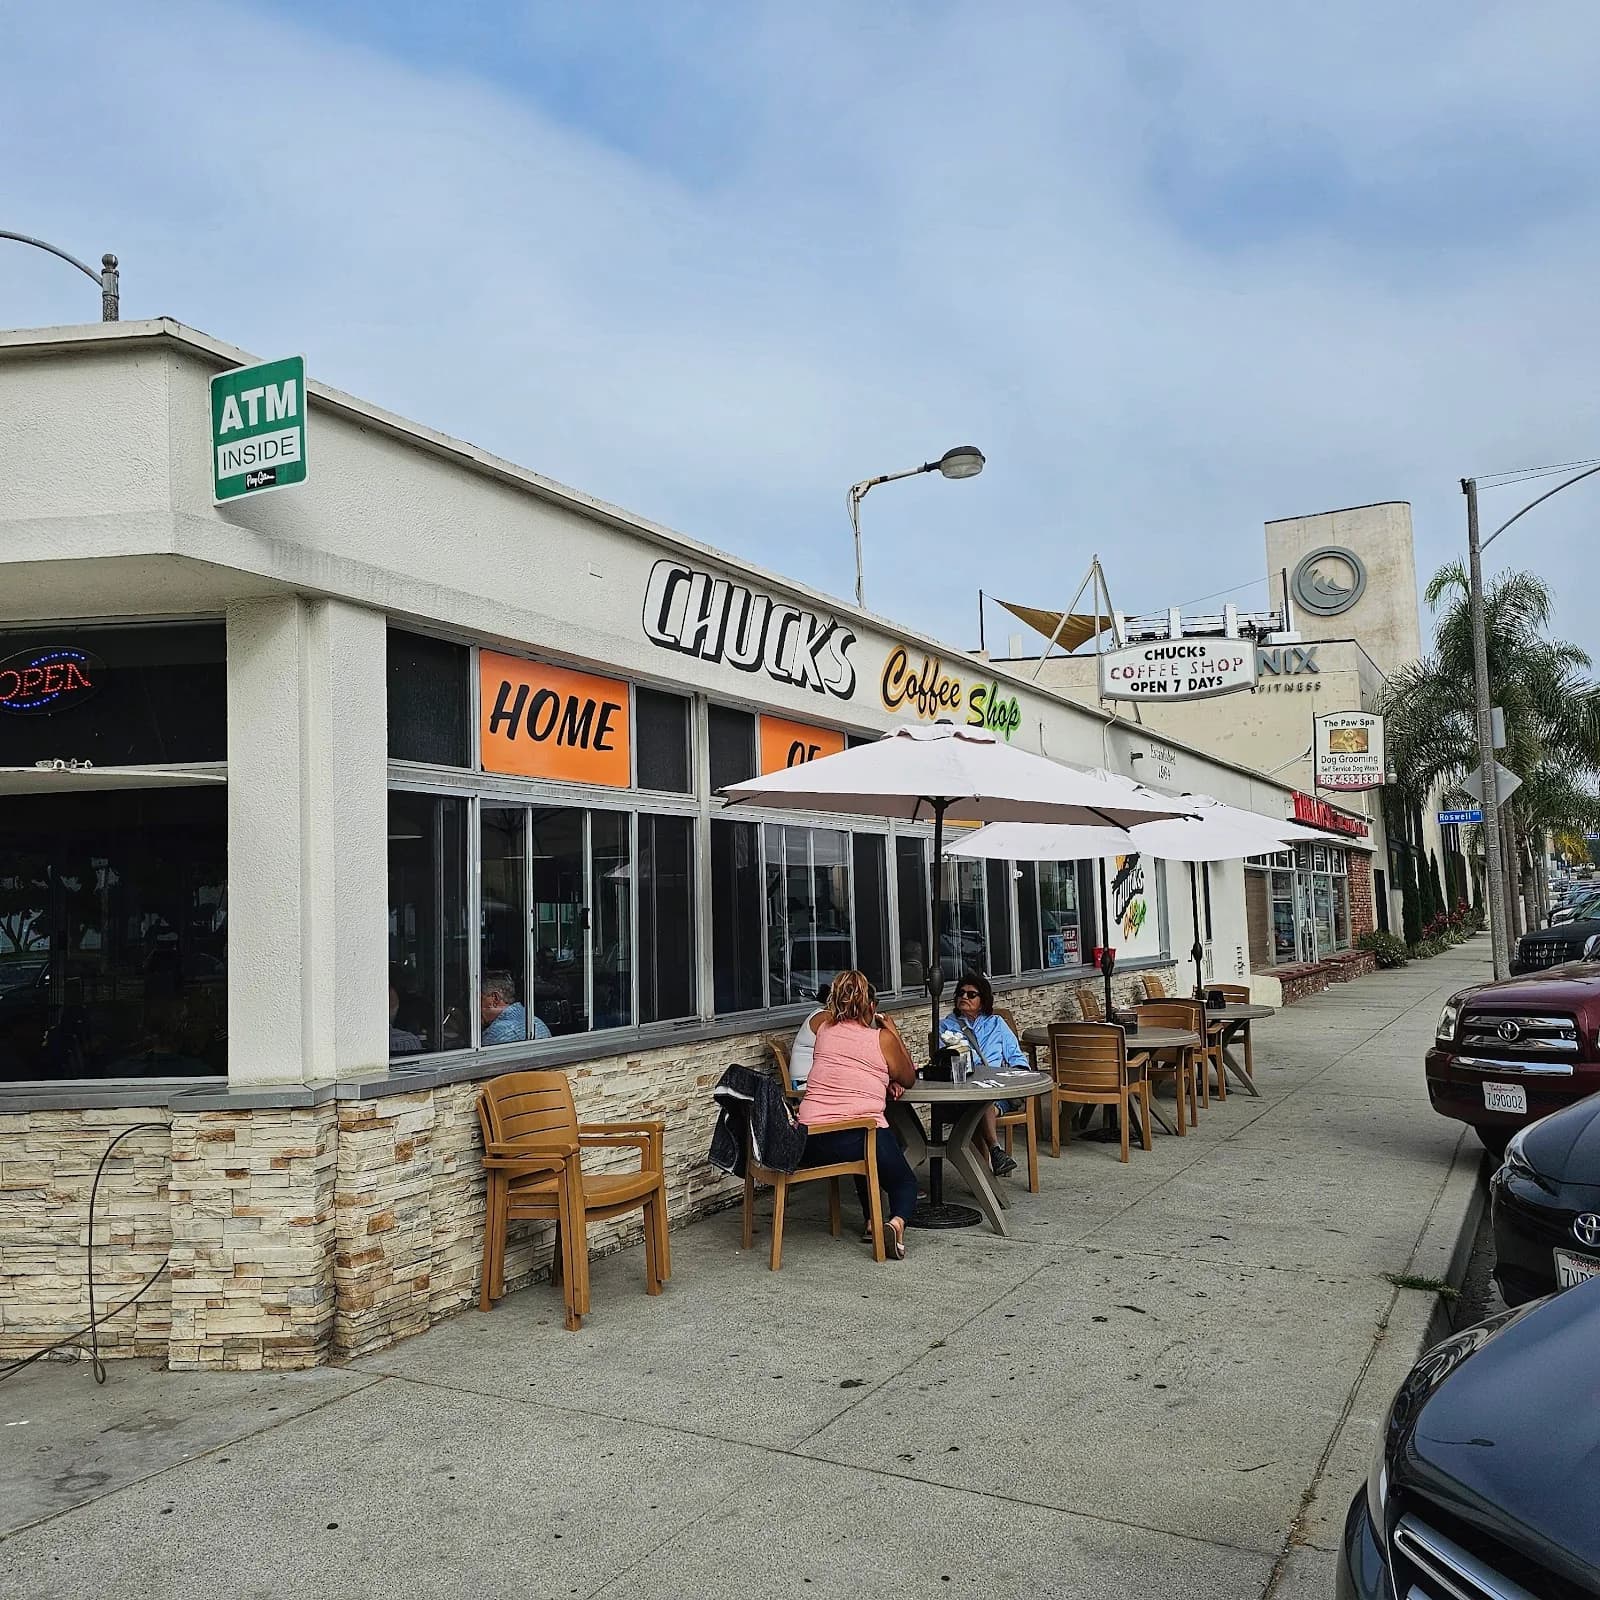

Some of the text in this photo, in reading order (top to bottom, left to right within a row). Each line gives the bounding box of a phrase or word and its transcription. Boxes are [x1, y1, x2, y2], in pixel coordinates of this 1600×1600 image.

[219, 379, 297, 435] ATM
[223, 435, 295, 471] INSIDE
[642, 559, 1021, 741] CHUCK'S Coffee Shop
[1144, 646, 1206, 661] CHUCKS
[1110, 657, 1243, 680] COFFEE SHOP
[0, 663, 91, 701] OPEN
[1130, 675, 1223, 693] OPEN 7 DAYS
[1259, 681, 1321, 693] FITNESS
[489, 680, 622, 752] HOME
[1359, 718, 1375, 726] Spa
[1321, 754, 1378, 765] Dog Grooming
[1439, 812, 1471, 822] Roswell
